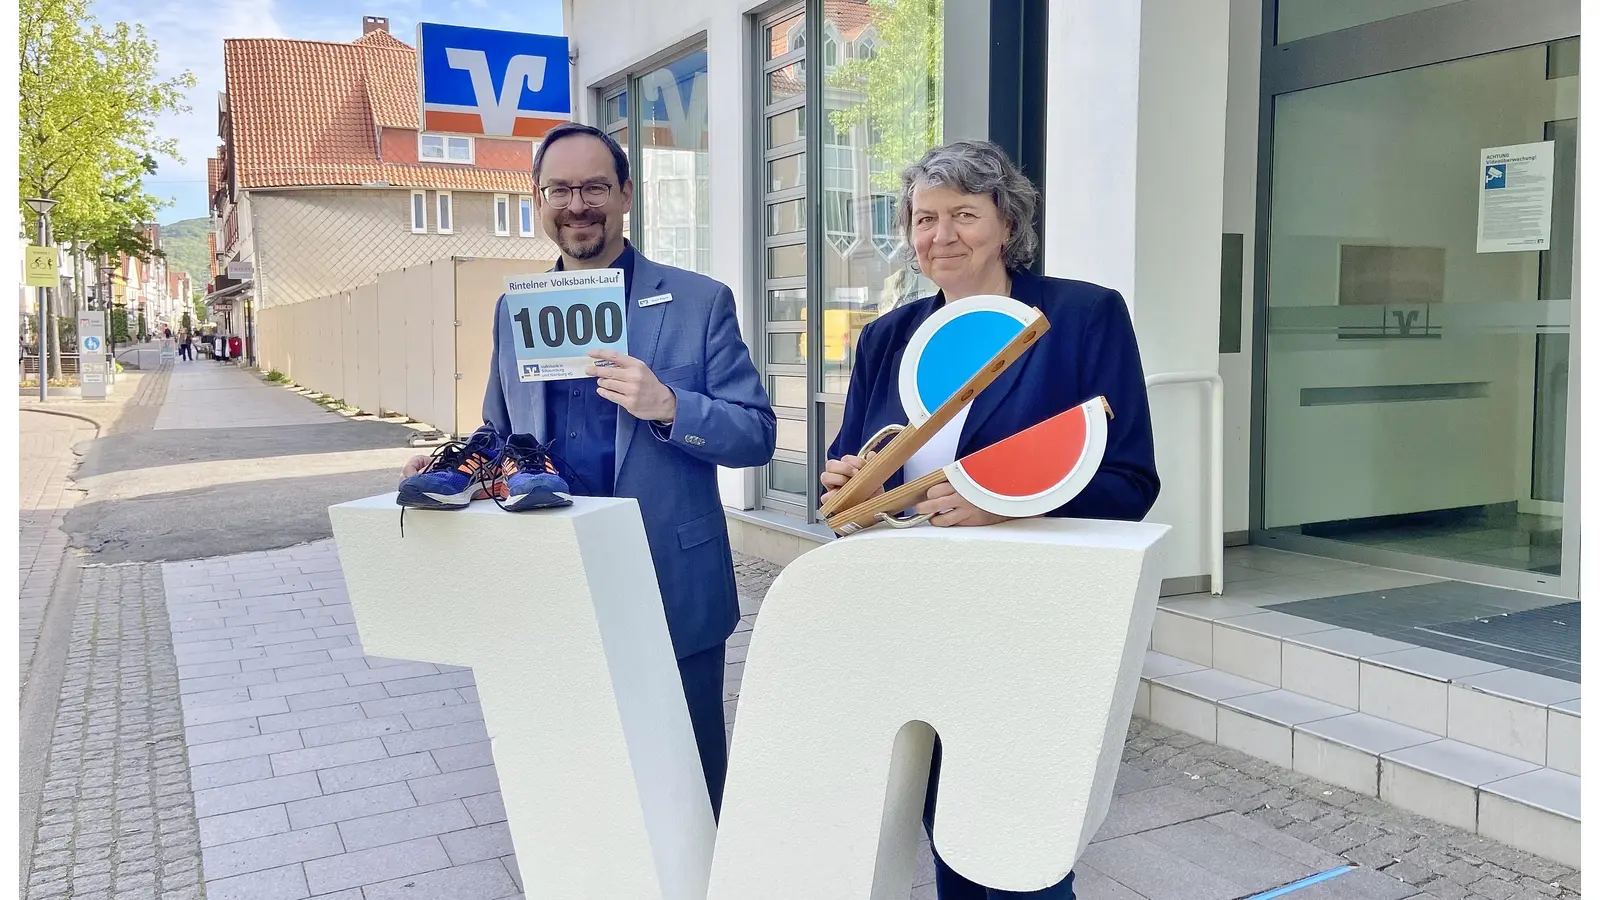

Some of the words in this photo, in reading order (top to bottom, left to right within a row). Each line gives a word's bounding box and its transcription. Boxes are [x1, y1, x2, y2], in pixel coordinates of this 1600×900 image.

[509, 280, 547, 290] Rintelner
[550, 275, 619, 287] Volksbank-Lauf
[514, 302, 622, 348] 1000
